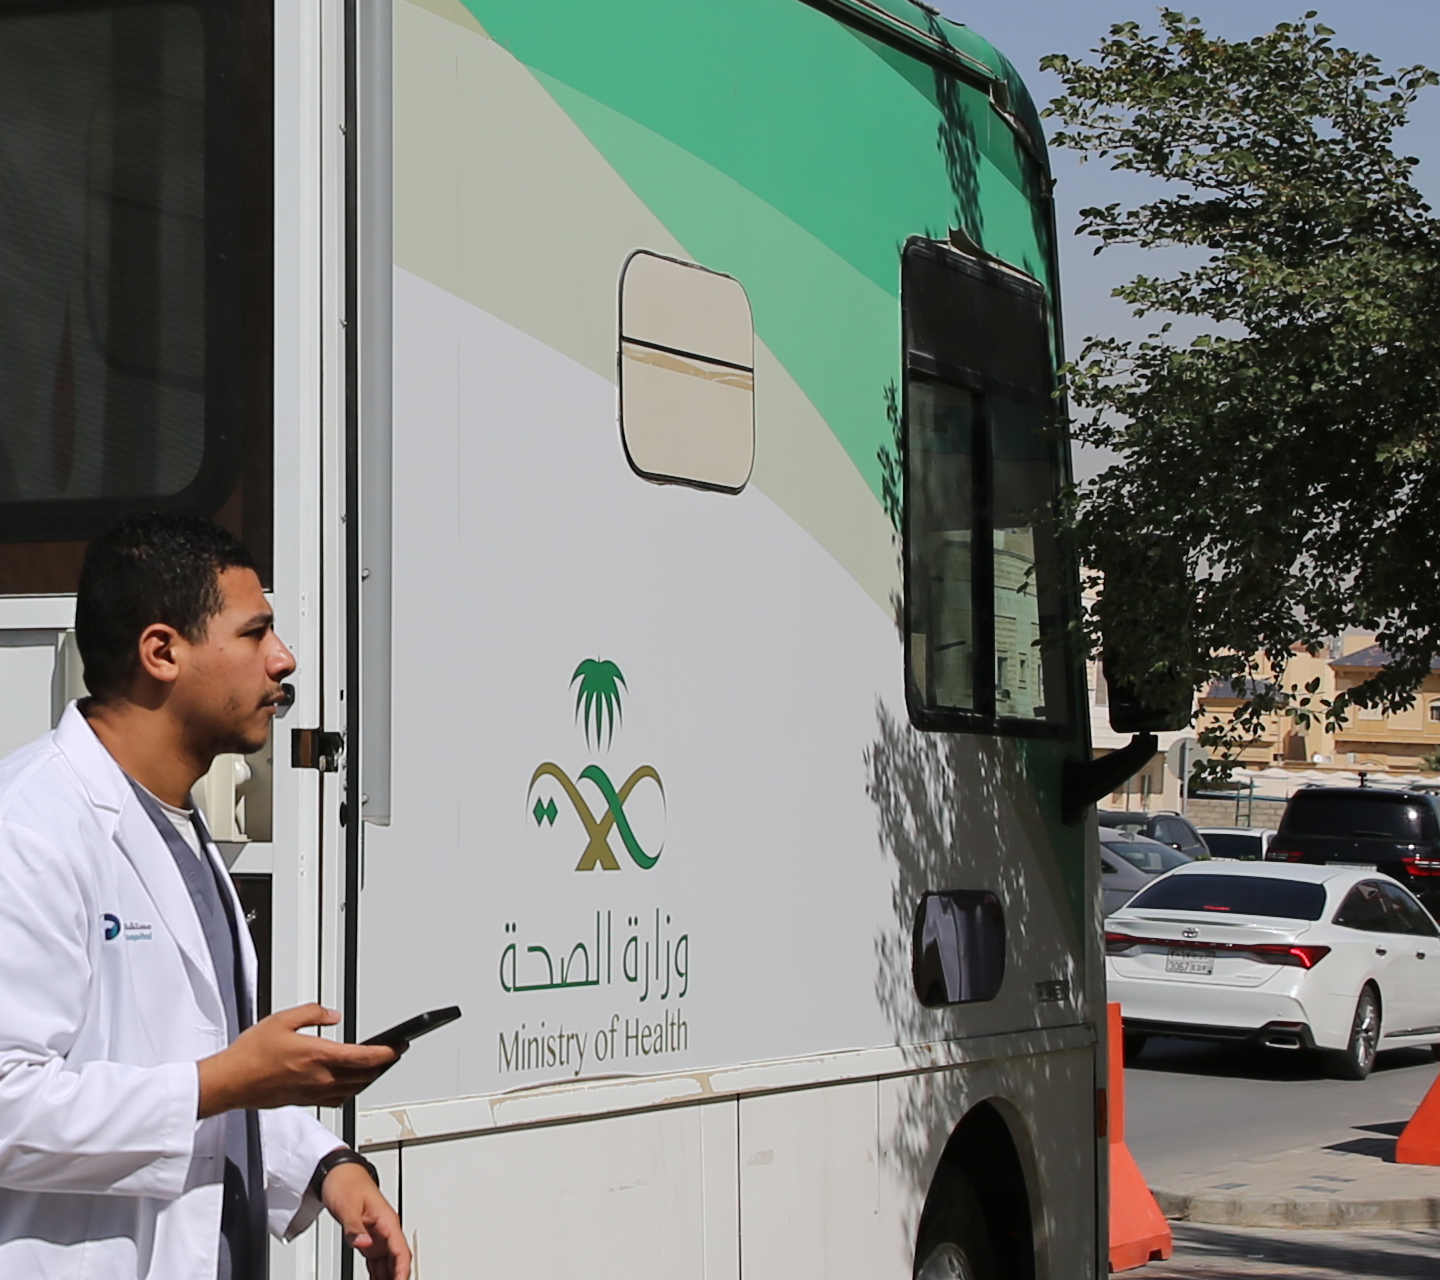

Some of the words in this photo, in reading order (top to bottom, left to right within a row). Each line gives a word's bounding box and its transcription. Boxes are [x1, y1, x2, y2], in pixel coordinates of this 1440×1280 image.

[499, 910, 612, 993] الصحة
[622, 908, 689, 1002] وزارة
[1168, 961, 1190, 972] 3067
[498, 1022, 588, 1078] Ministry
[594, 1013, 620, 1062] of
[624, 1007, 688, 1058] Health
